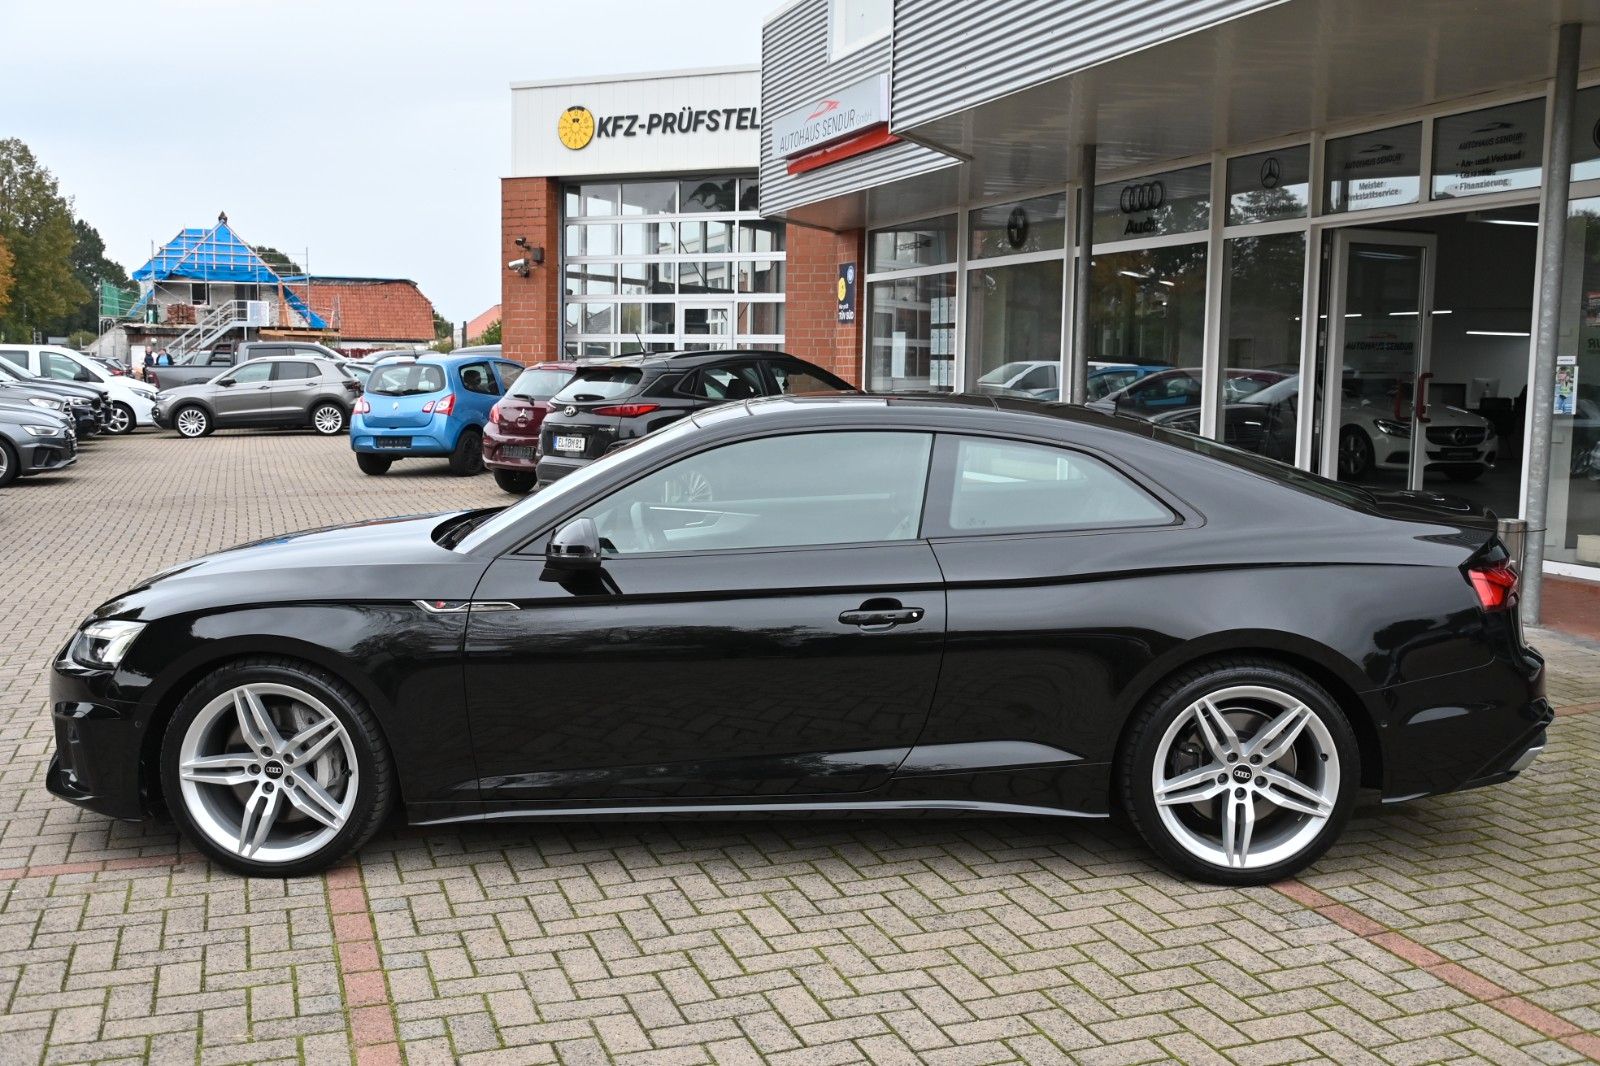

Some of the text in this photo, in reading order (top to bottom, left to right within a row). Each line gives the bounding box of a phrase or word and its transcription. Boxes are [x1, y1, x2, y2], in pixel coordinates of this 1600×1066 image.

[597, 107, 760, 138] KFZ-PRÜFSTEL
[780, 123, 820, 153] AUTOHAUS
[822, 109, 856, 137] SENDUR
[1359, 181, 1384, 190] Meister
[1459, 179, 1509, 190] Finanzierung
[1124, 217, 1157, 235] Audi
